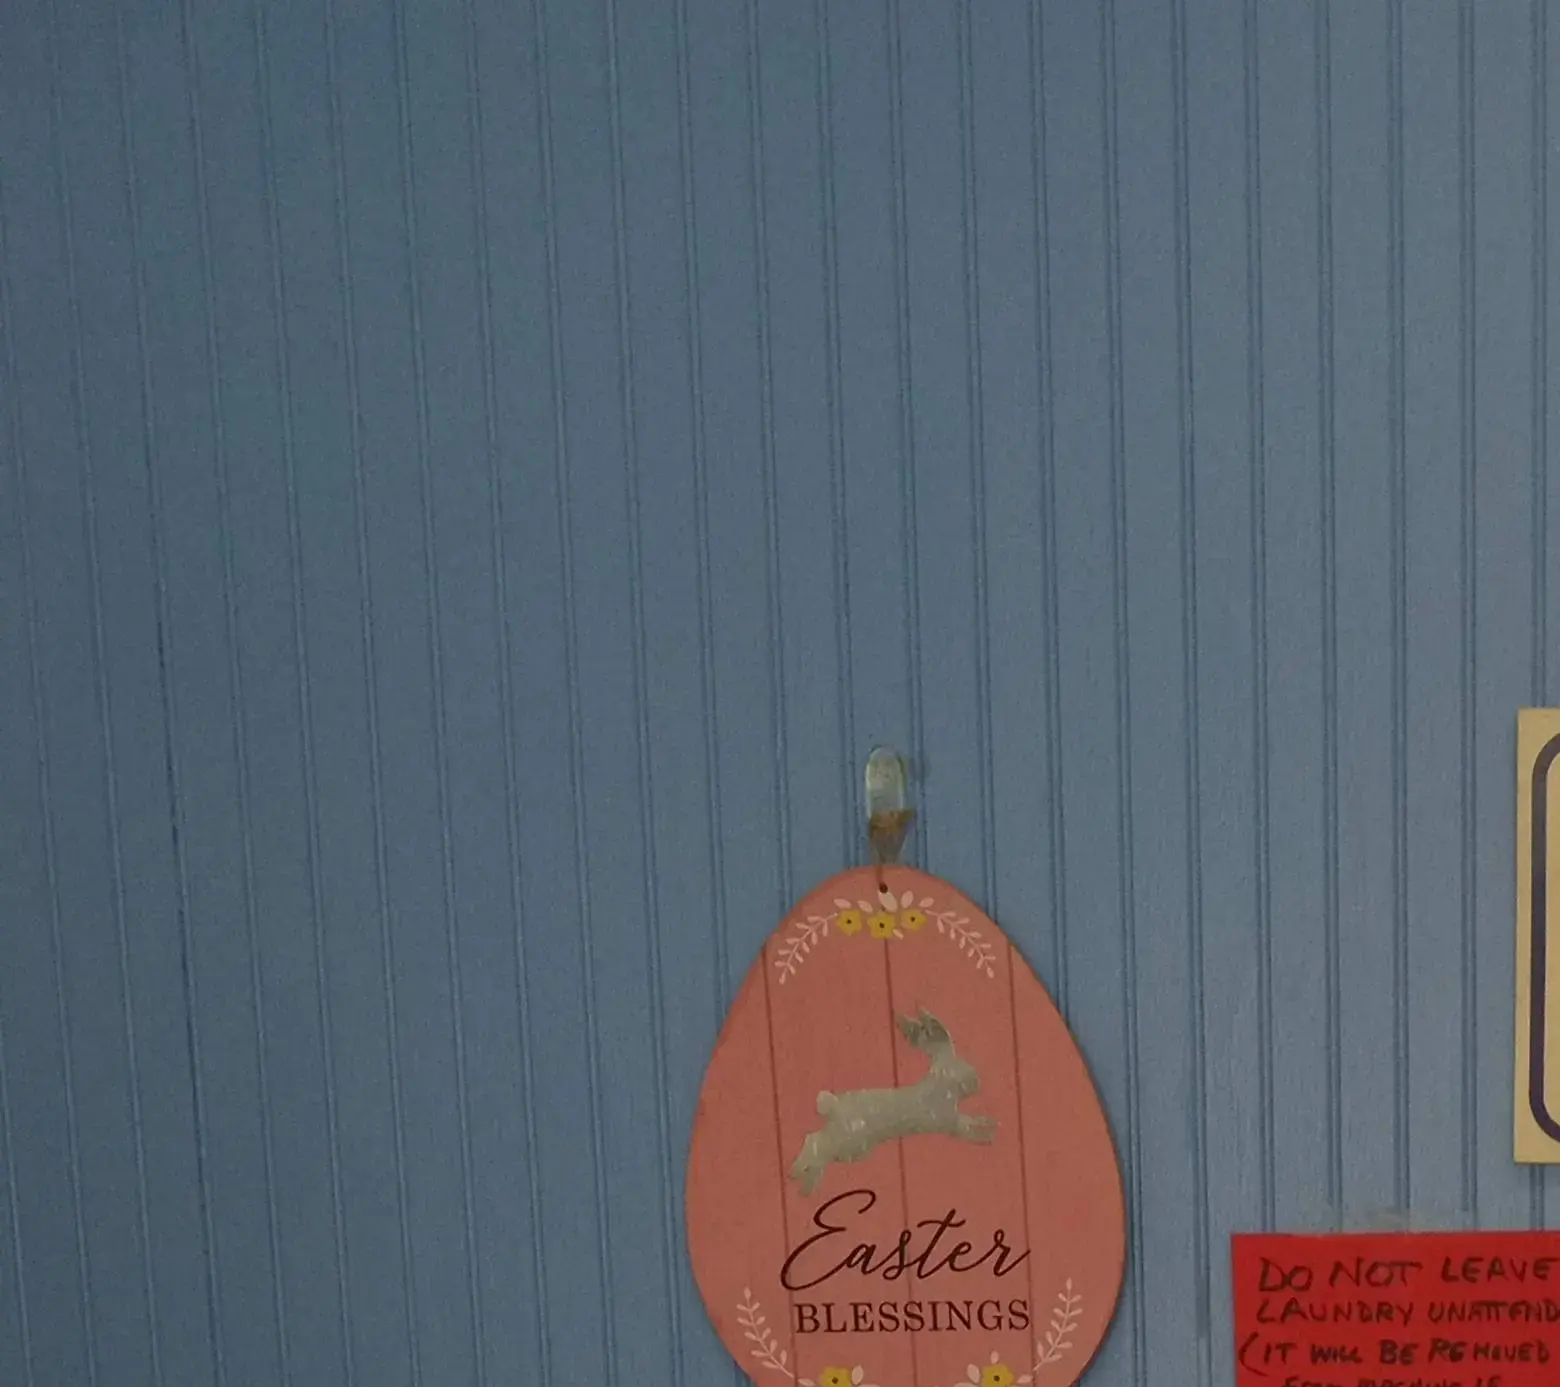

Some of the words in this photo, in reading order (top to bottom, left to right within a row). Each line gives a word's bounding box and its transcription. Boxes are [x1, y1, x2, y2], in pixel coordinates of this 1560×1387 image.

[780, 1189, 1031, 1292] Easter
[1259, 1257, 1313, 1292] DO
[1329, 1257, 1422, 1288] NOT
[1441, 1256, 1560, 1284] LEAVE
[793, 1299, 1030, 1334] BLESSINGS
[1257, 1297, 1414, 1326] LAUNDRY
[1310, 1343, 1363, 1364] WILL
[1380, 1339, 1418, 1365] BE
[1428, 1338, 1550, 1364] REMOVED
